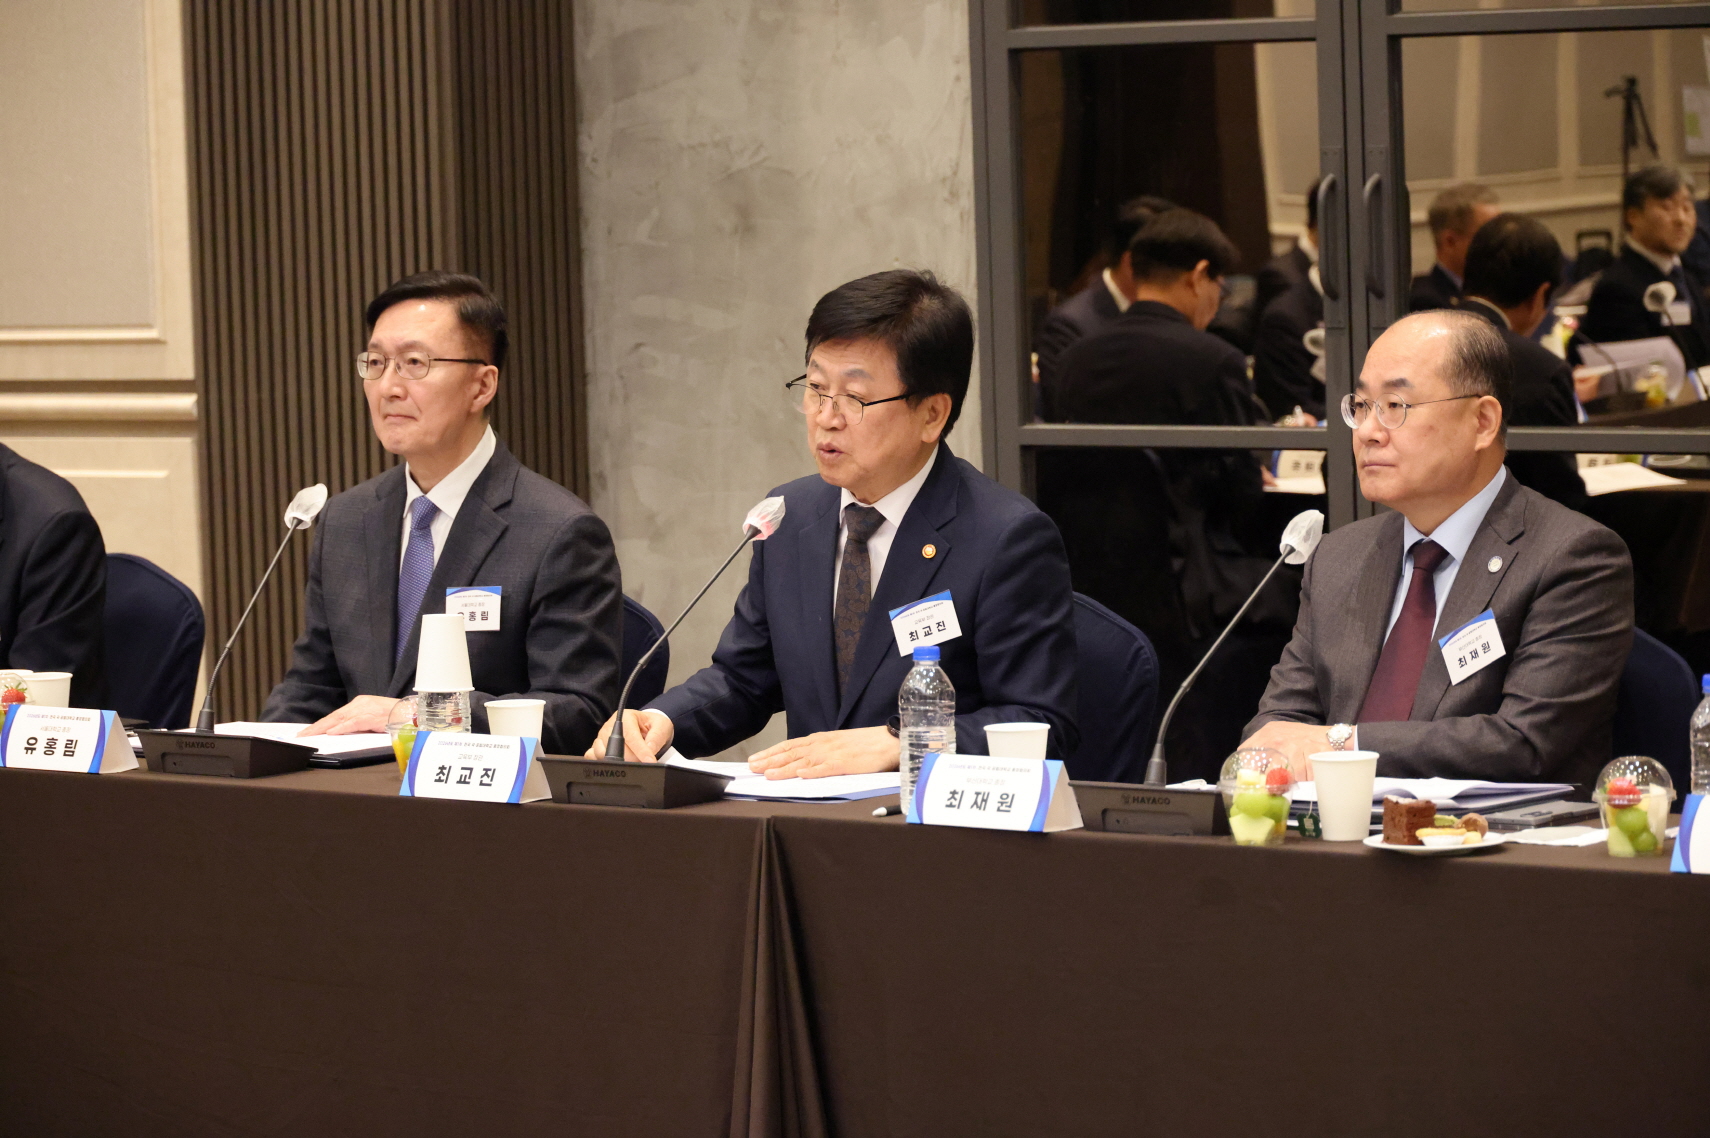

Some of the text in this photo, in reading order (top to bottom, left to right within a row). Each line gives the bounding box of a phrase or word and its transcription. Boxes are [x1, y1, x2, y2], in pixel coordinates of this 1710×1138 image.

[457, 610, 489, 622] 홍림
[909, 620, 947, 642] 최교진
[1457, 640, 1491, 669] 최재원
[24, 736, 79, 758] 유홍림
[185, 741, 216, 749] HAYACO
[434, 764, 497, 787] 최교진
[593, 769, 627, 778] HAYACO
[945, 789, 1016, 813] 최재원
[1132, 796, 1171, 805] HAYACO
